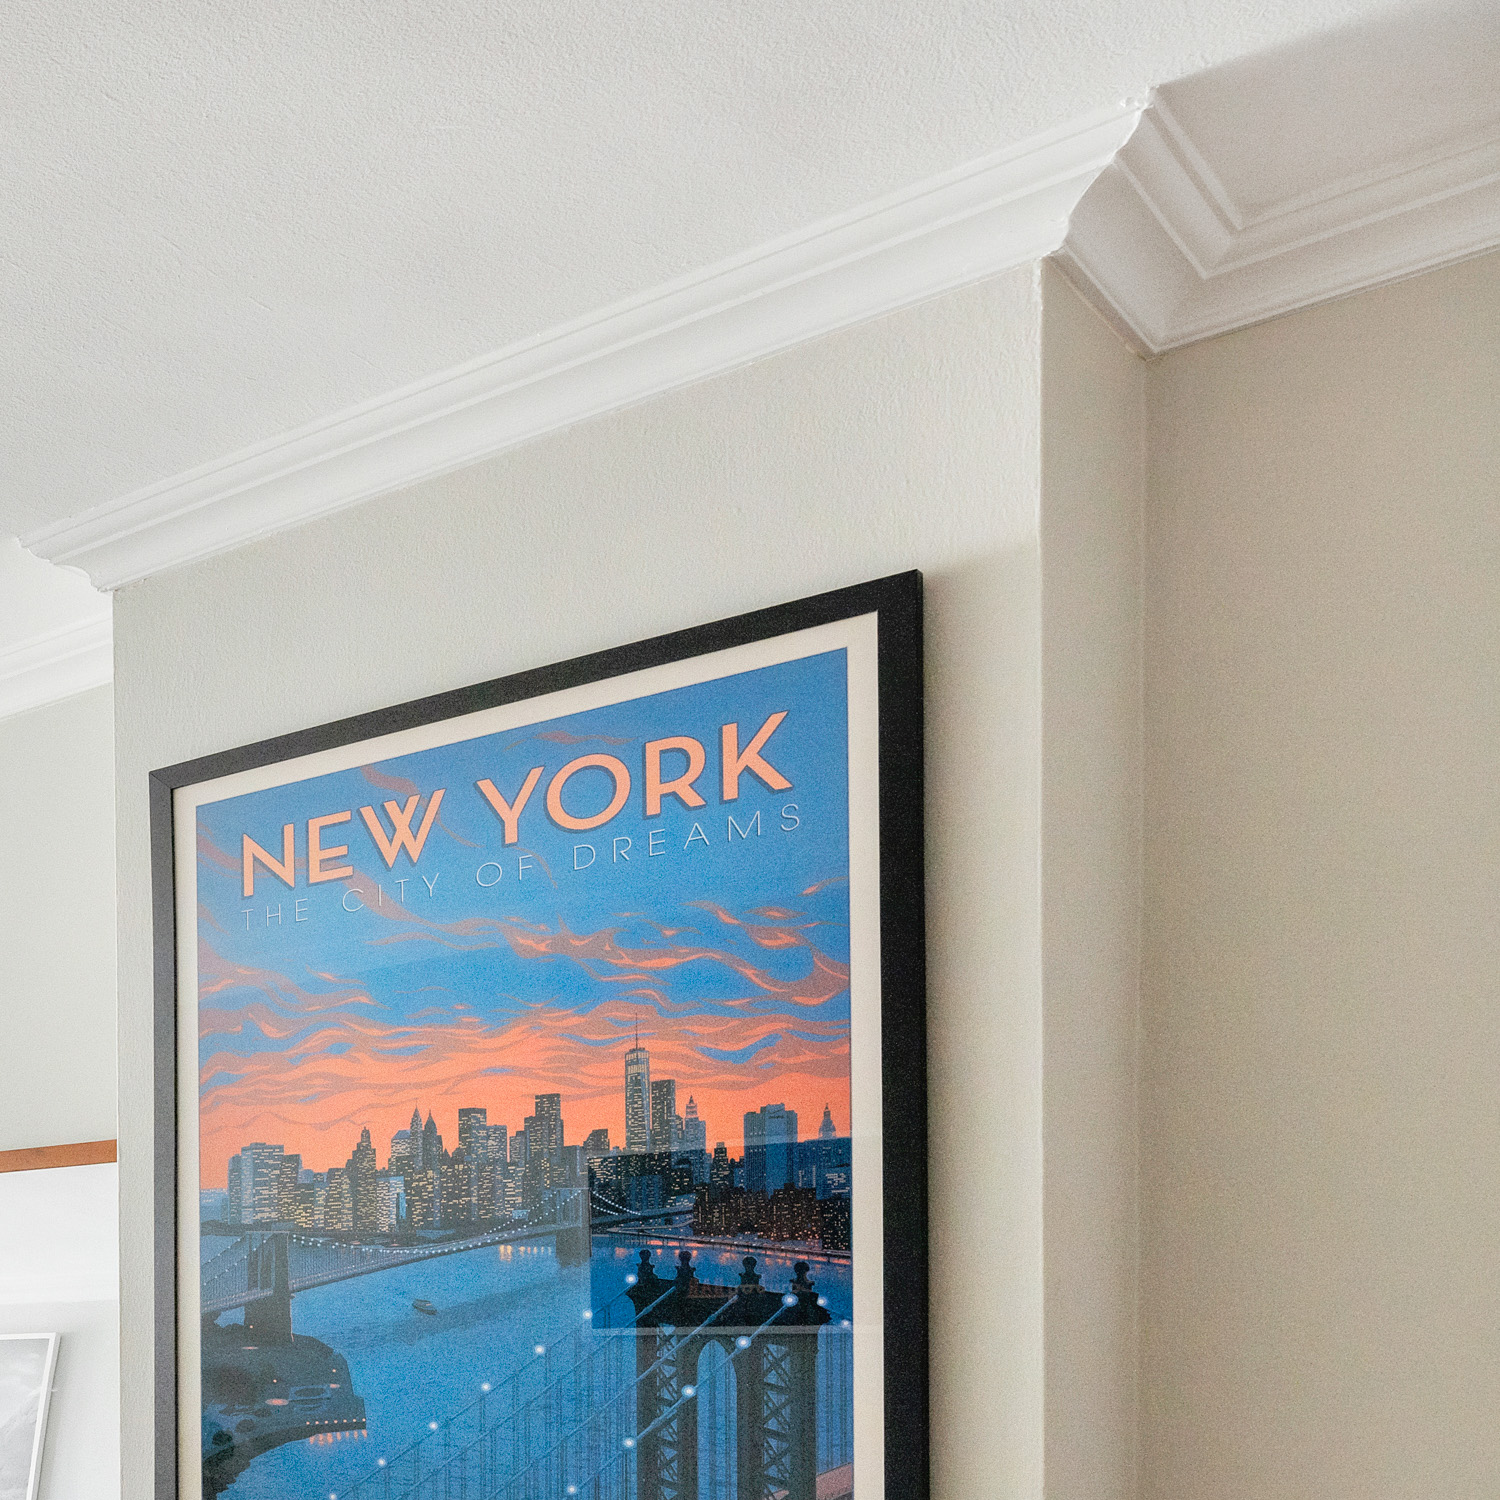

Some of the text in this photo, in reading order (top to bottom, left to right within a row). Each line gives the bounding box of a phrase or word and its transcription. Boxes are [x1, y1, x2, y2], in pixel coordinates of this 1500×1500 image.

[240, 710, 793, 898] NEW YORK
[241, 803, 802, 932] THE CITY OF DREAMS
